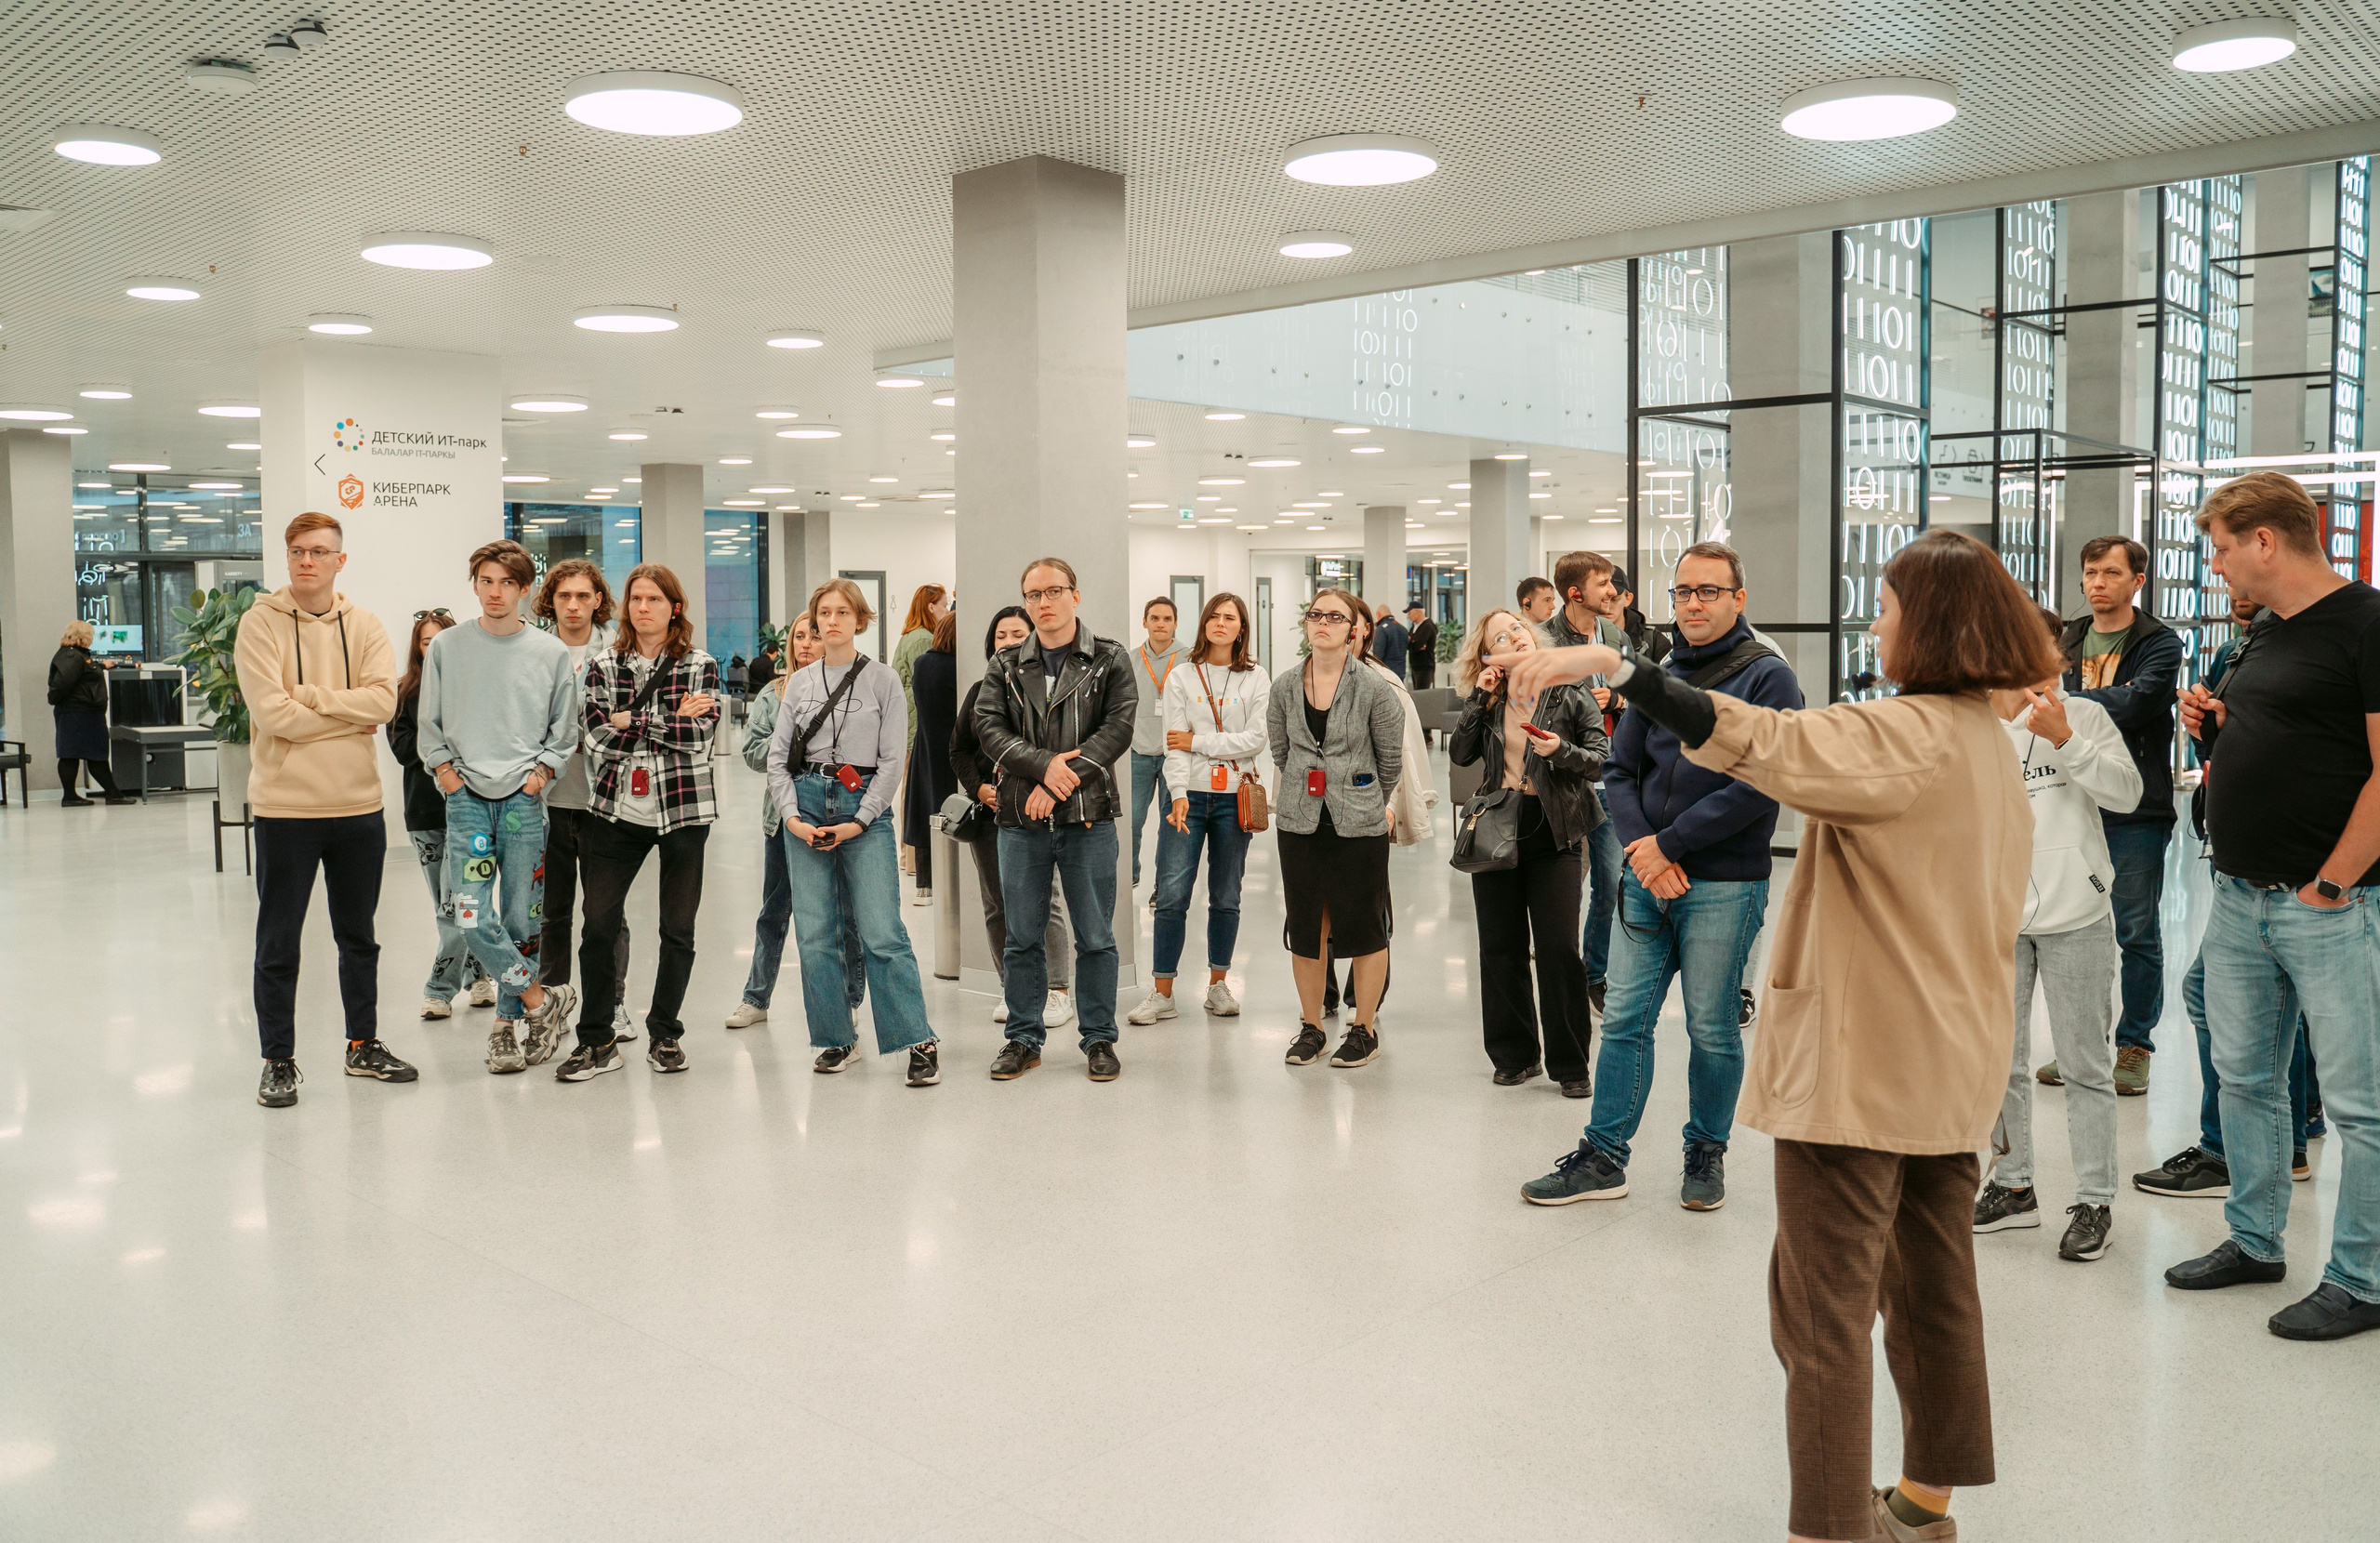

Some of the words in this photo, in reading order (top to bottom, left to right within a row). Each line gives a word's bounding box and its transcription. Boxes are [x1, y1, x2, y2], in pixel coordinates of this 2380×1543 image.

[372, 431, 434, 445] ДЕТСКИЙ
[438, 435, 487, 449] ИТ-парк
[372, 447, 414, 457] БАЛАЛАР
[373, 482, 451, 495] КИБЕРПАРК
[374, 495, 417, 507] АРЕНА
